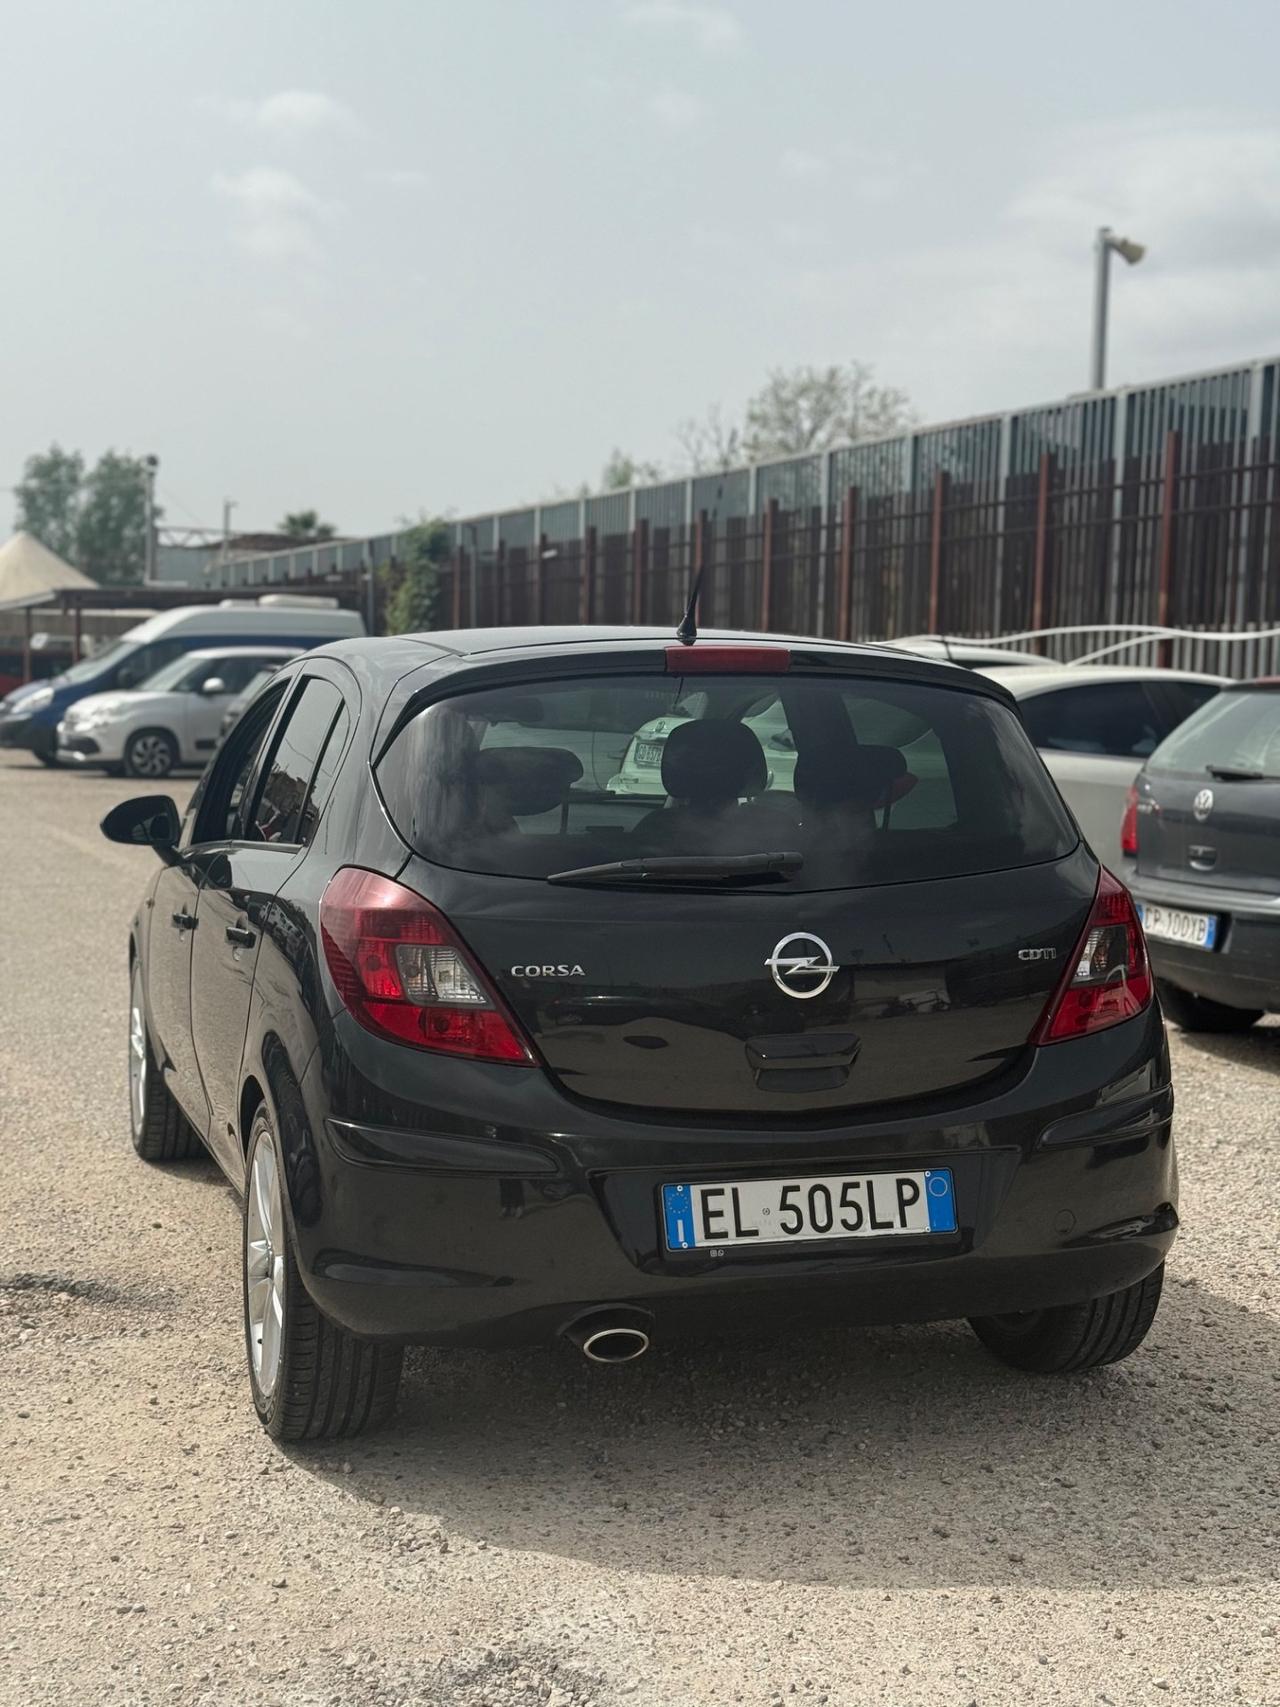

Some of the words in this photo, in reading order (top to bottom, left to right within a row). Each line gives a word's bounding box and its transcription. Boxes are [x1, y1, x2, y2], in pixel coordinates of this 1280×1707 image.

[1145, 906, 1162, 930] CP
[1018, 948, 1057, 960] CDTI
[511, 964, 586, 977] CORSA
[700, 1187, 760, 1240] EL
[779, 1177, 921, 1235] 505LP
